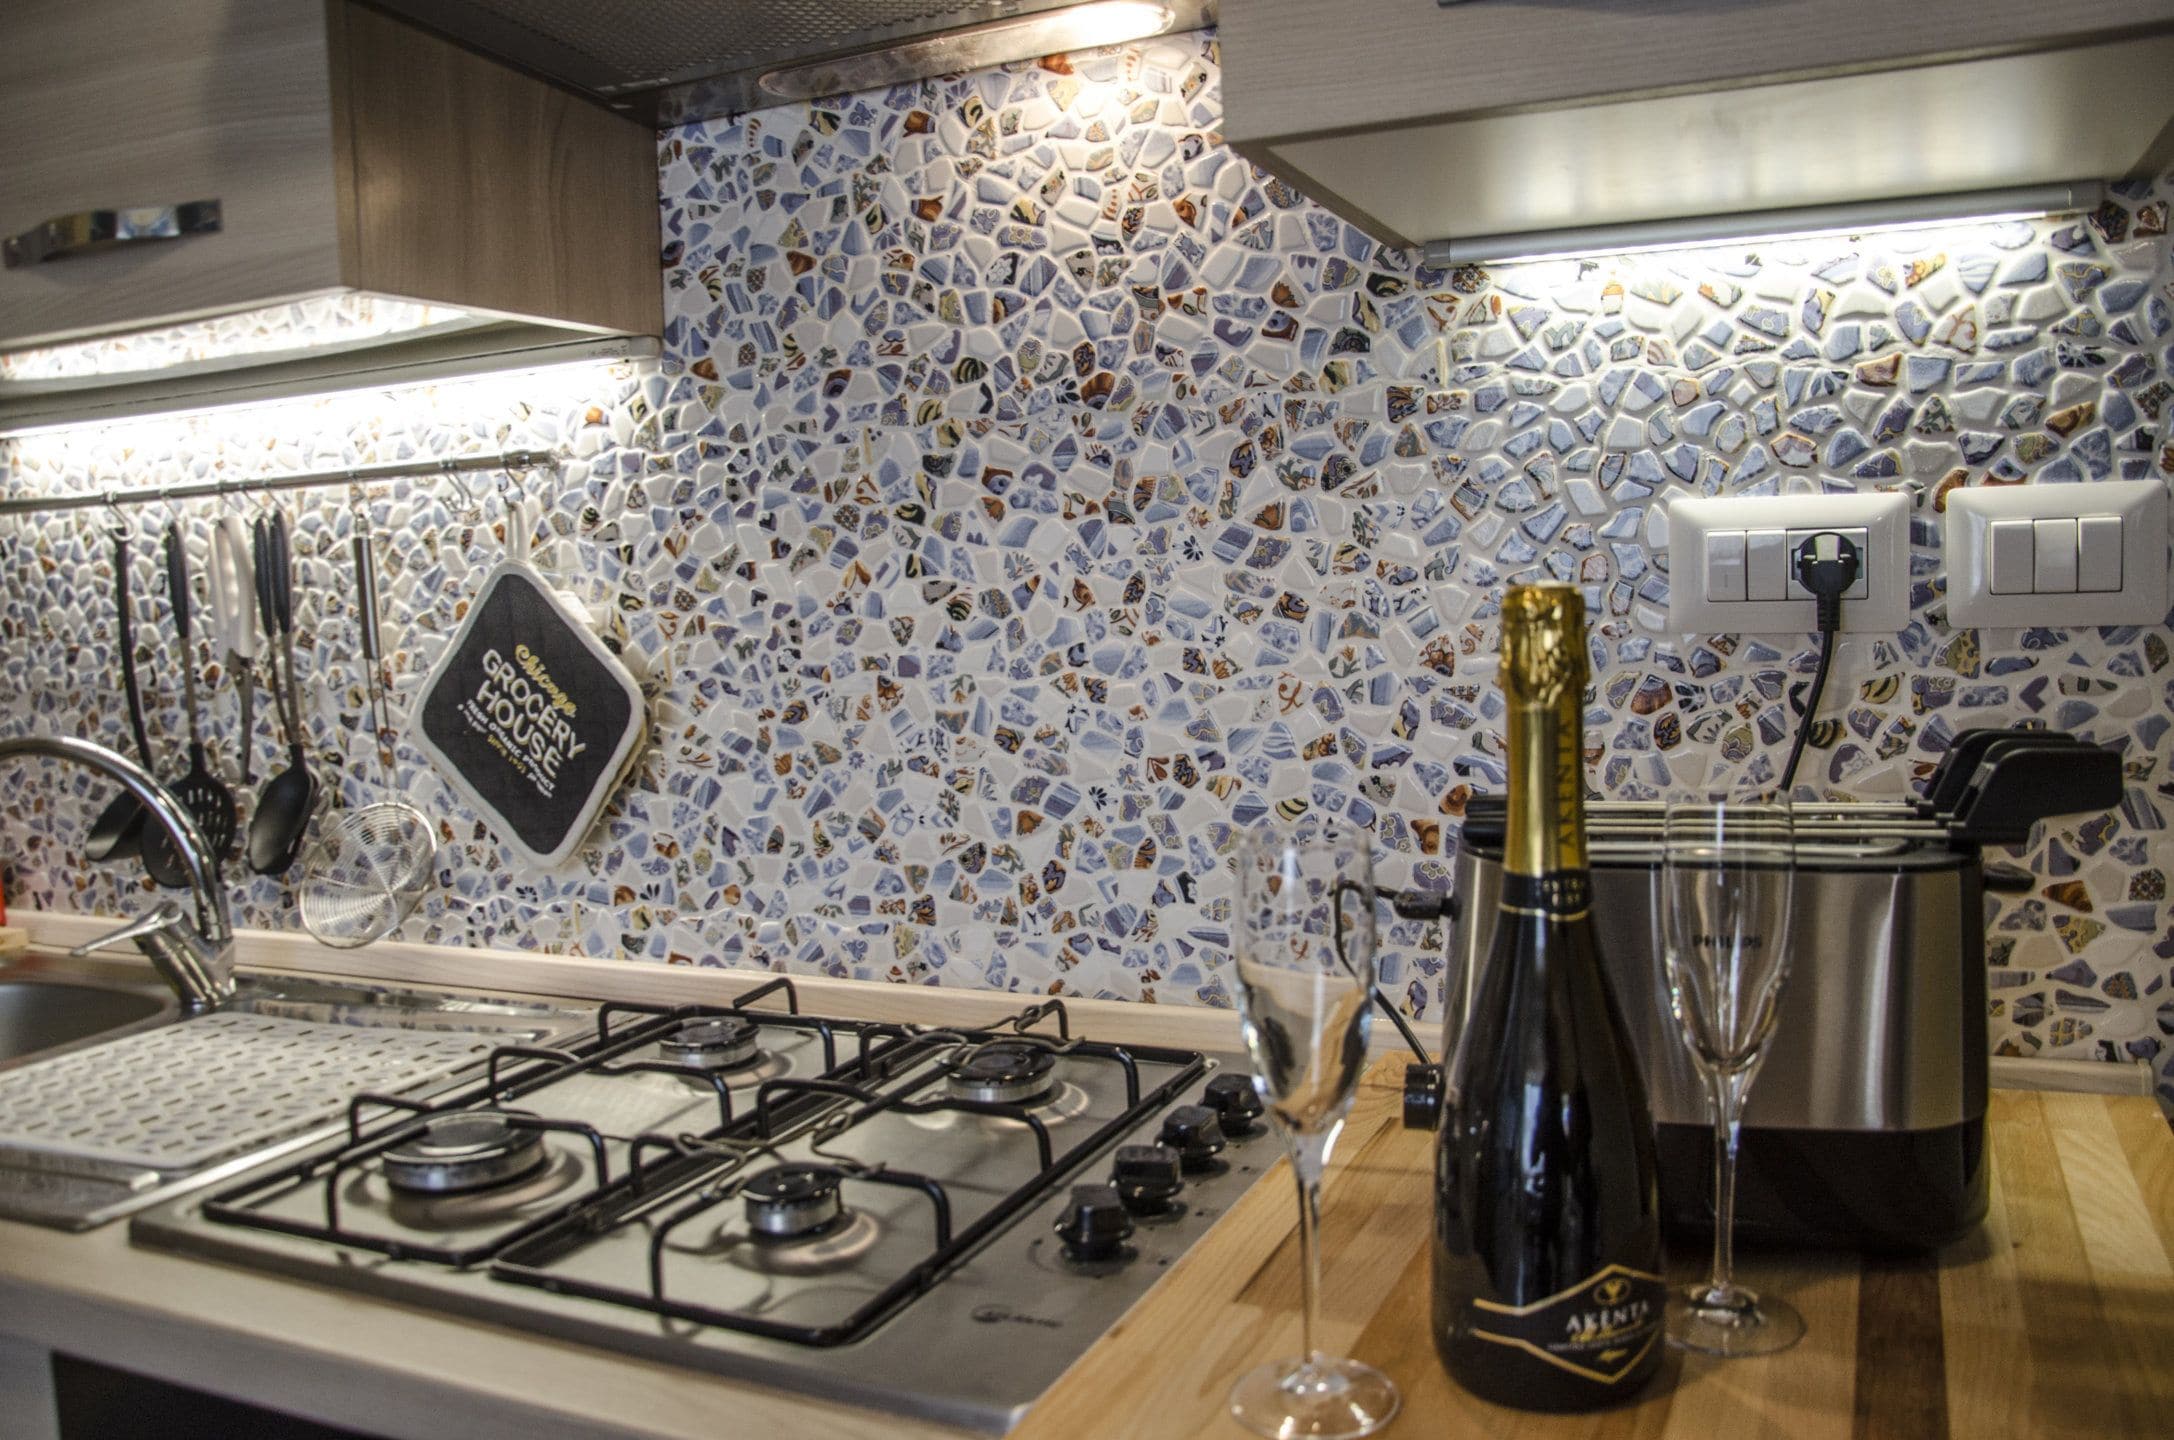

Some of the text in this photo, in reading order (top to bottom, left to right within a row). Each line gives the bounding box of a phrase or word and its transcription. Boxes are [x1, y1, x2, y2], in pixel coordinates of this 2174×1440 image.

[482, 649, 586, 759] GROCERY
[515, 644, 577, 718] Chicago
[476, 679, 563, 778] HOUSE
[488, 721, 523, 758] ORGANIC
